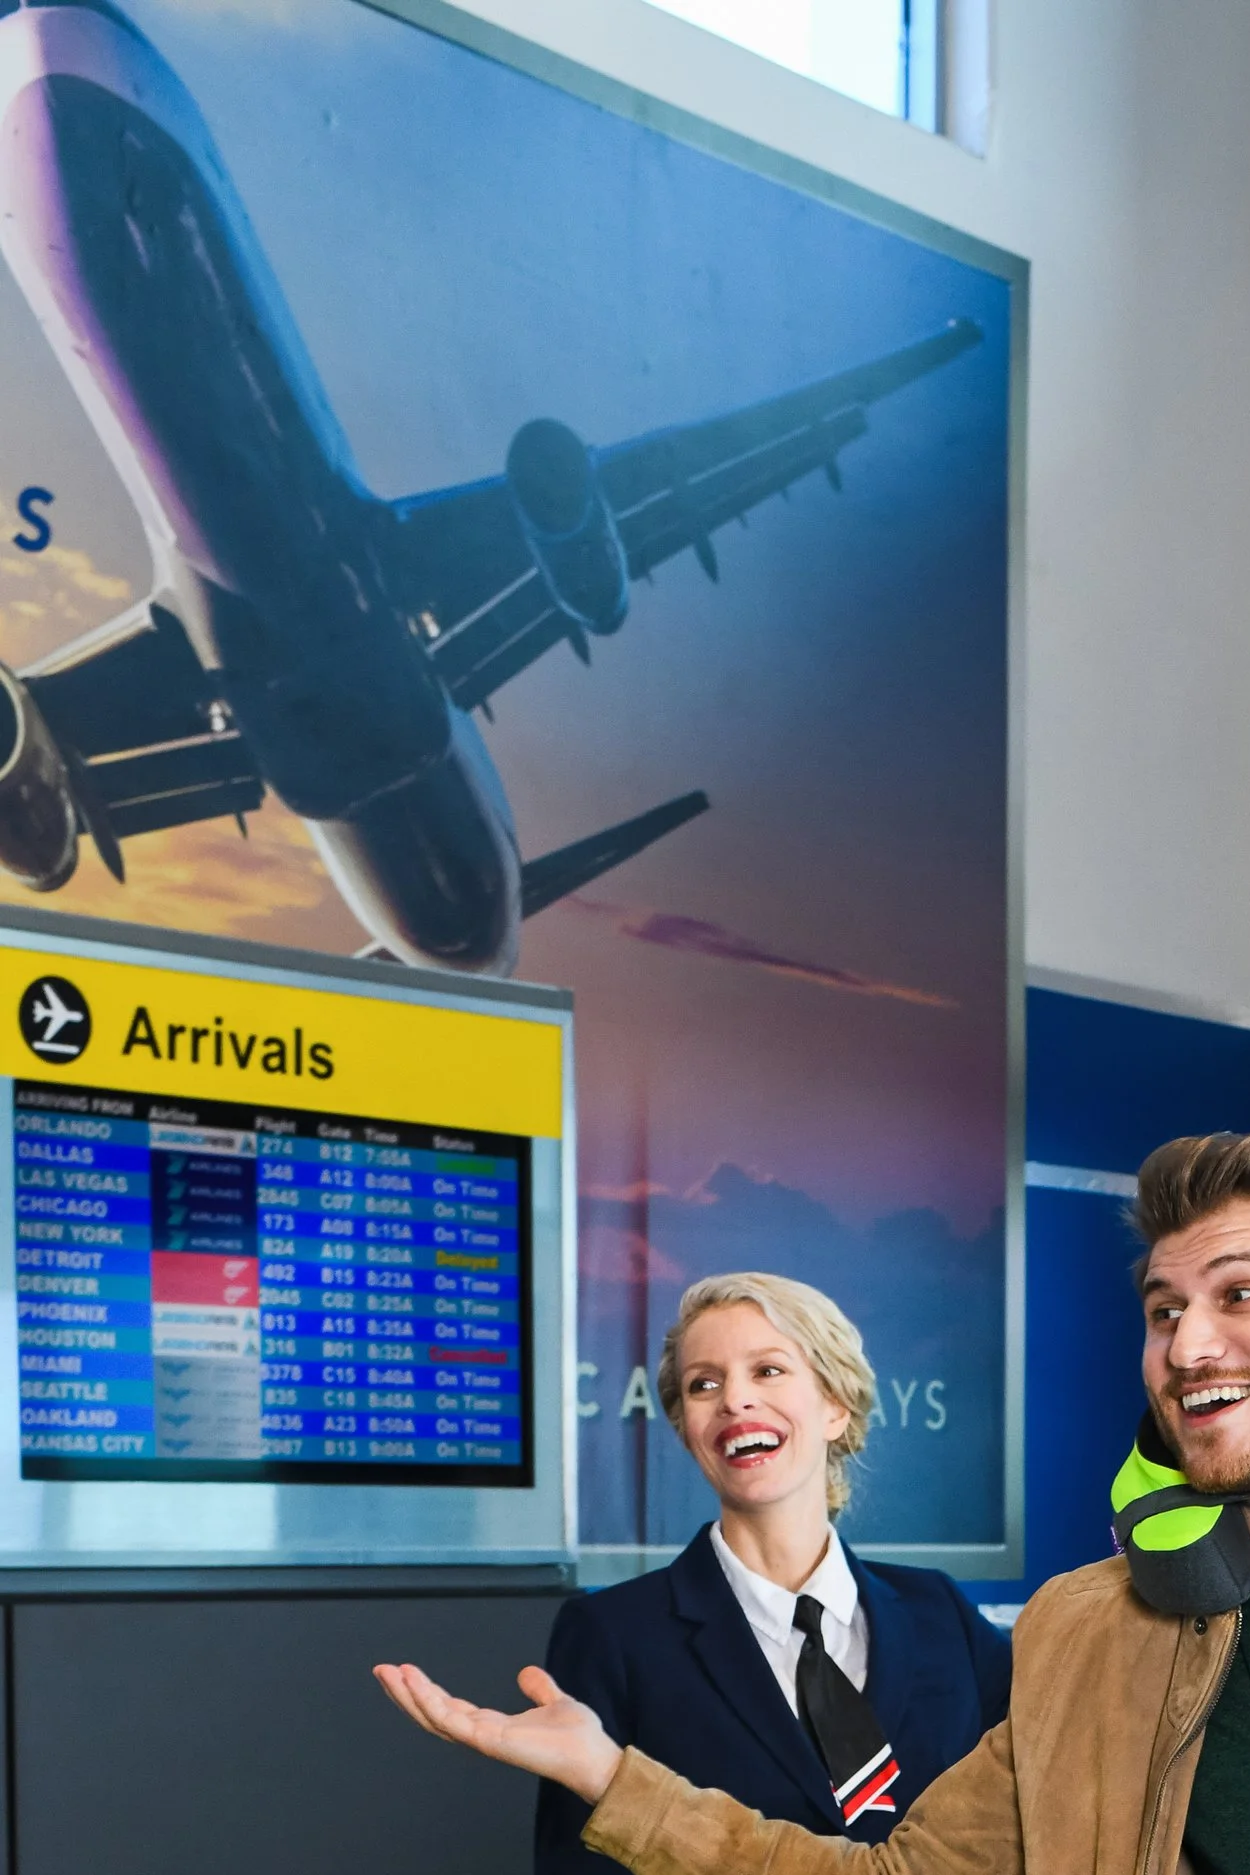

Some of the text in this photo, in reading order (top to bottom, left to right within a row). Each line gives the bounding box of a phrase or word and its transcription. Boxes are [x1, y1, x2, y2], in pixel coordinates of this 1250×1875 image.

[121, 1006, 335, 1081] Arrivals
[16, 1115, 111, 1139] ORLANDO
[262, 1137, 293, 1155] 274
[92, 1099, 134, 1115] FROM
[149, 1105, 198, 1124] Airline
[255, 1116, 297, 1134] Flight
[317, 1123, 351, 1139] Gate
[363, 1127, 398, 1143] Time
[432, 1135, 475, 1152] Status
[18, 1141, 94, 1164] DALLAS
[320, 1169, 353, 1187] A12
[432, 1178, 456, 1195] On
[460, 1180, 498, 1198] Time
[20, 1170, 56, 1187] LAS
[63, 1173, 128, 1193] VEGAS
[320, 1193, 354, 1210] C07
[433, 1202, 456, 1218] On
[461, 1204, 499, 1221] Time
[17, 1196, 108, 1218] CHICAGO
[263, 1213, 295, 1231] 173
[433, 1226, 456, 1242] On
[461, 1228, 499, 1245] Time
[19, 1222, 63, 1239] NEW
[71, 1226, 123, 1243] YORK
[18, 1249, 102, 1269] DETROIT
[434, 1274, 457, 1290] On
[461, 1276, 500, 1293] Time
[18, 1275, 99, 1295] DENVER
[435, 1298, 457, 1314] On
[462, 1299, 499, 1316] Time
[19, 1302, 108, 1323] PHOENIX
[322, 1317, 355, 1334] A15
[434, 1322, 458, 1338] On
[462, 1323, 500, 1340] Time
[19, 1329, 116, 1349] HOUSTON
[322, 1341, 353, 1357] B01
[21, 1356, 82, 1374] MIAMI
[322, 1366, 356, 1383] C15
[435, 1370, 458, 1386] On
[462, 1371, 501, 1387] Time
[20, 1381, 108, 1401] SEATTLE
[436, 1394, 458, 1409] On
[463, 1394, 501, 1411] Time
[868, 1379, 946, 1431] AYS
[21, 1409, 118, 1428] OAKLAND
[324, 1416, 356, 1432] A23
[435, 1418, 459, 1434] On
[463, 1419, 501, 1435] Time
[21, 1434, 98, 1452] KANSAS
[101, 1435, 144, 1453] CITY
[436, 1441, 459, 1458] On
[464, 1442, 502, 1458] Time
